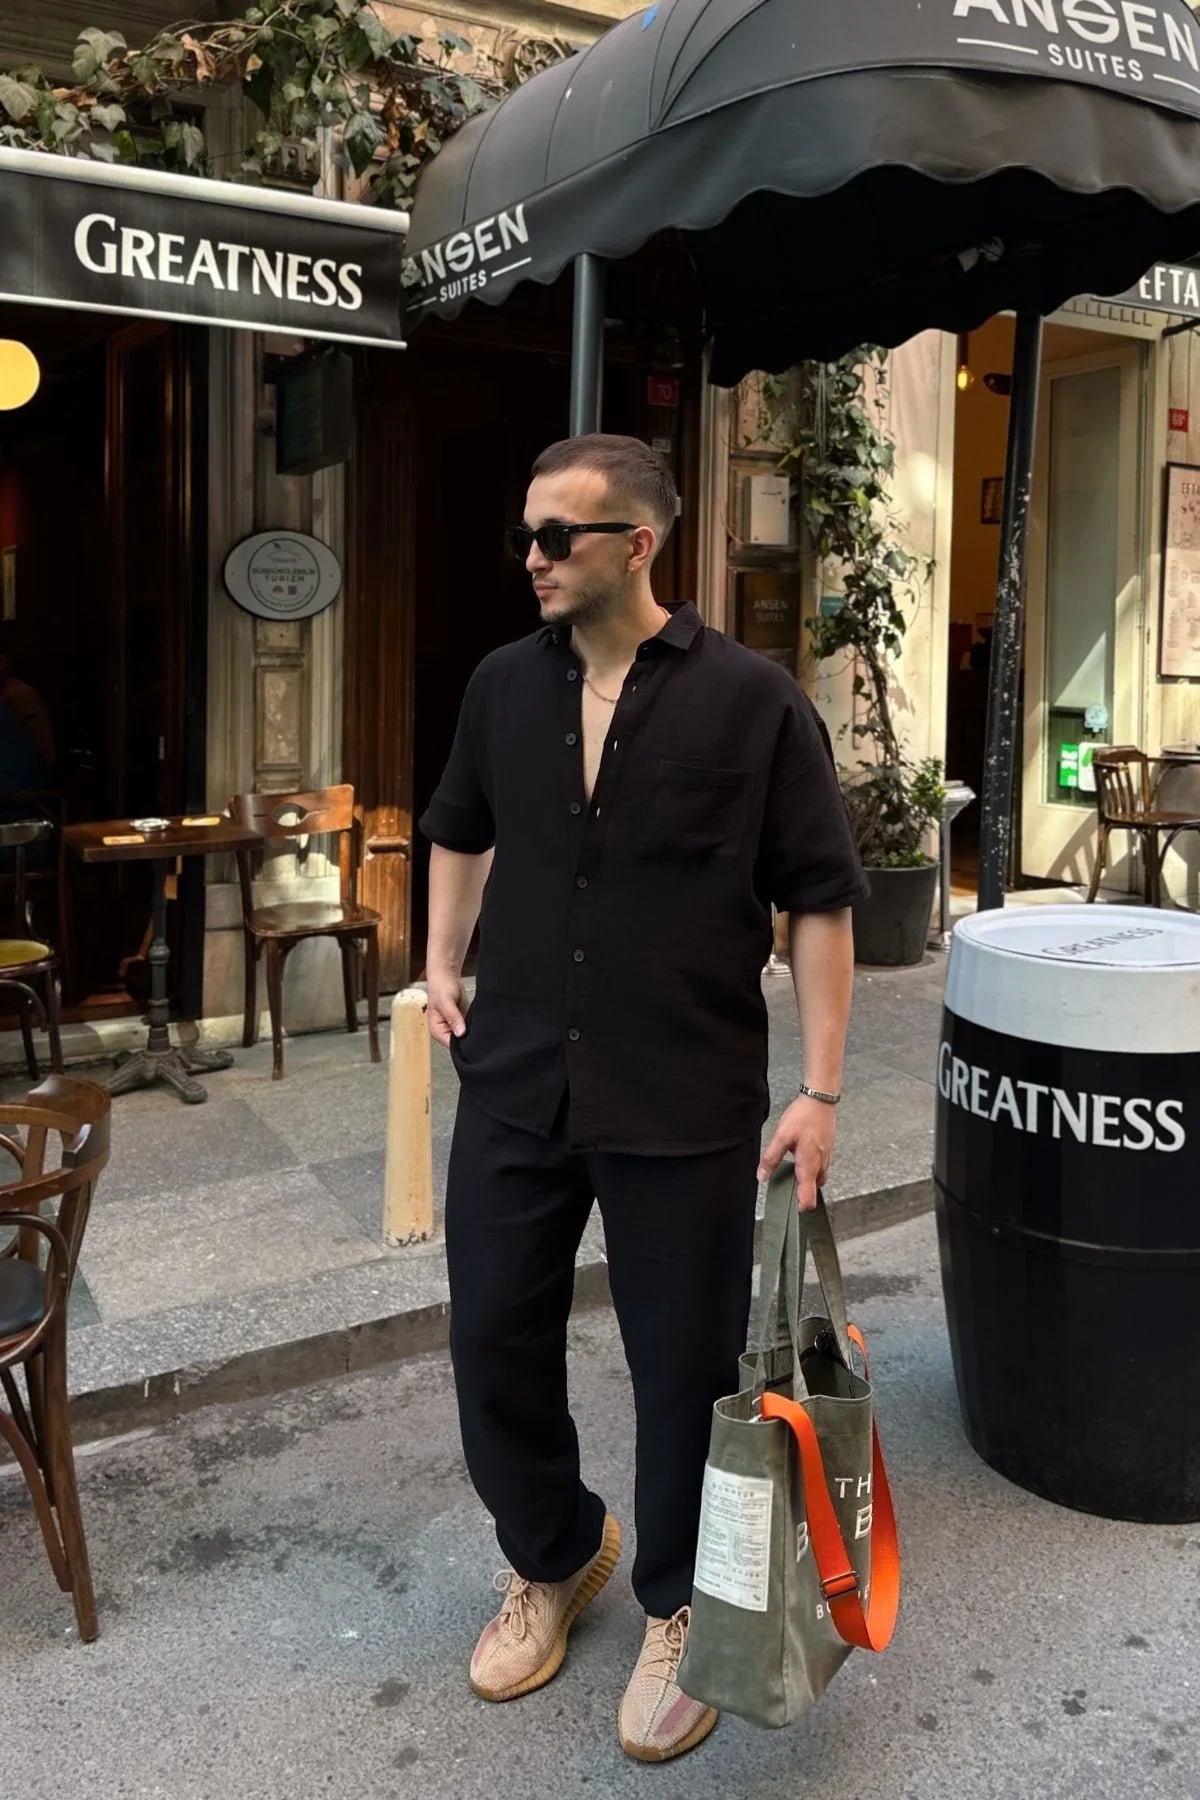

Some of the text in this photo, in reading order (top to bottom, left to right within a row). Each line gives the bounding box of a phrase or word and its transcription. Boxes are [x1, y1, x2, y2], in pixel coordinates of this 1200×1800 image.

[1047, 43, 1144, 82] SUITES
[74, 213, 363, 311] GREATNESS
[412, 203, 529, 287] NSEN
[440, 269, 487, 303] SUITES
[1138, 266, 1200, 308] EFTA
[657, 384, 672, 400] 70
[752, 599, 788, 610] ANSEN
[937, 1041, 1186, 1153] GREATNESS
